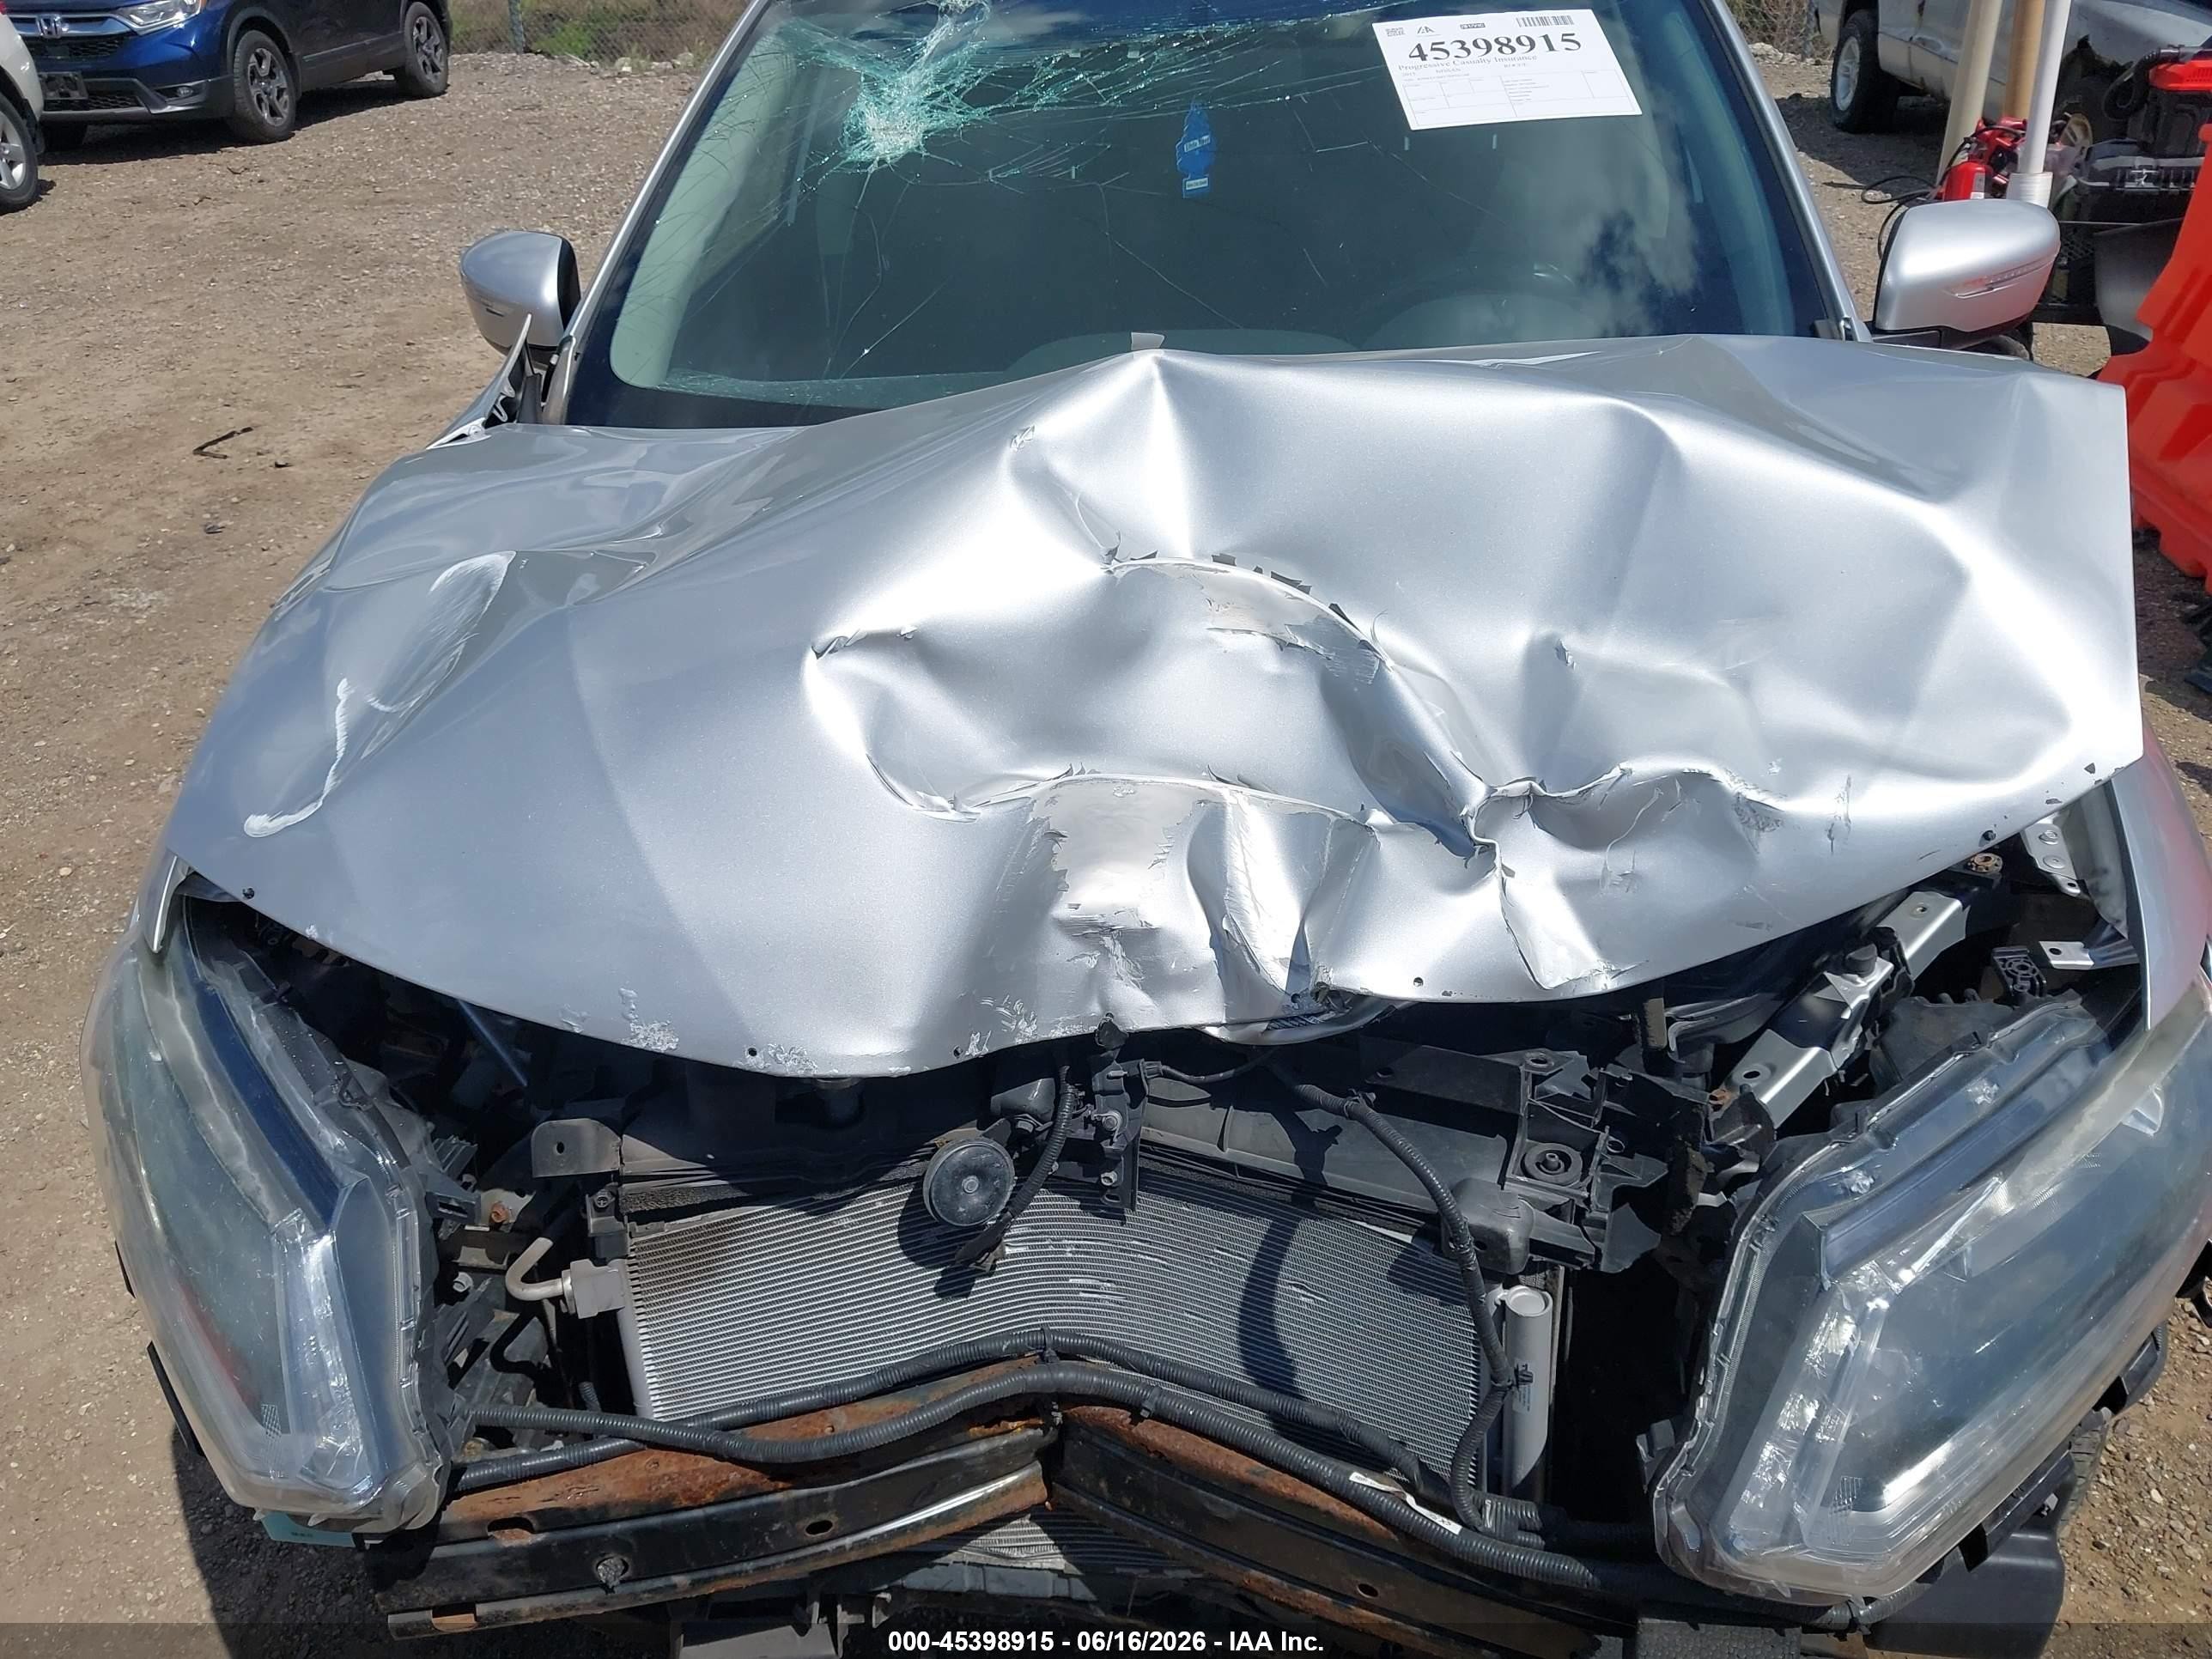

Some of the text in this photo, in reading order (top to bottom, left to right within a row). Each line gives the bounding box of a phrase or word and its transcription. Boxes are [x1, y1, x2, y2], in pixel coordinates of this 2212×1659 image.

[1408, 32, 1582, 62] 45398915
[1398, 54, 1537, 71] Progressive Casualty Insurance
